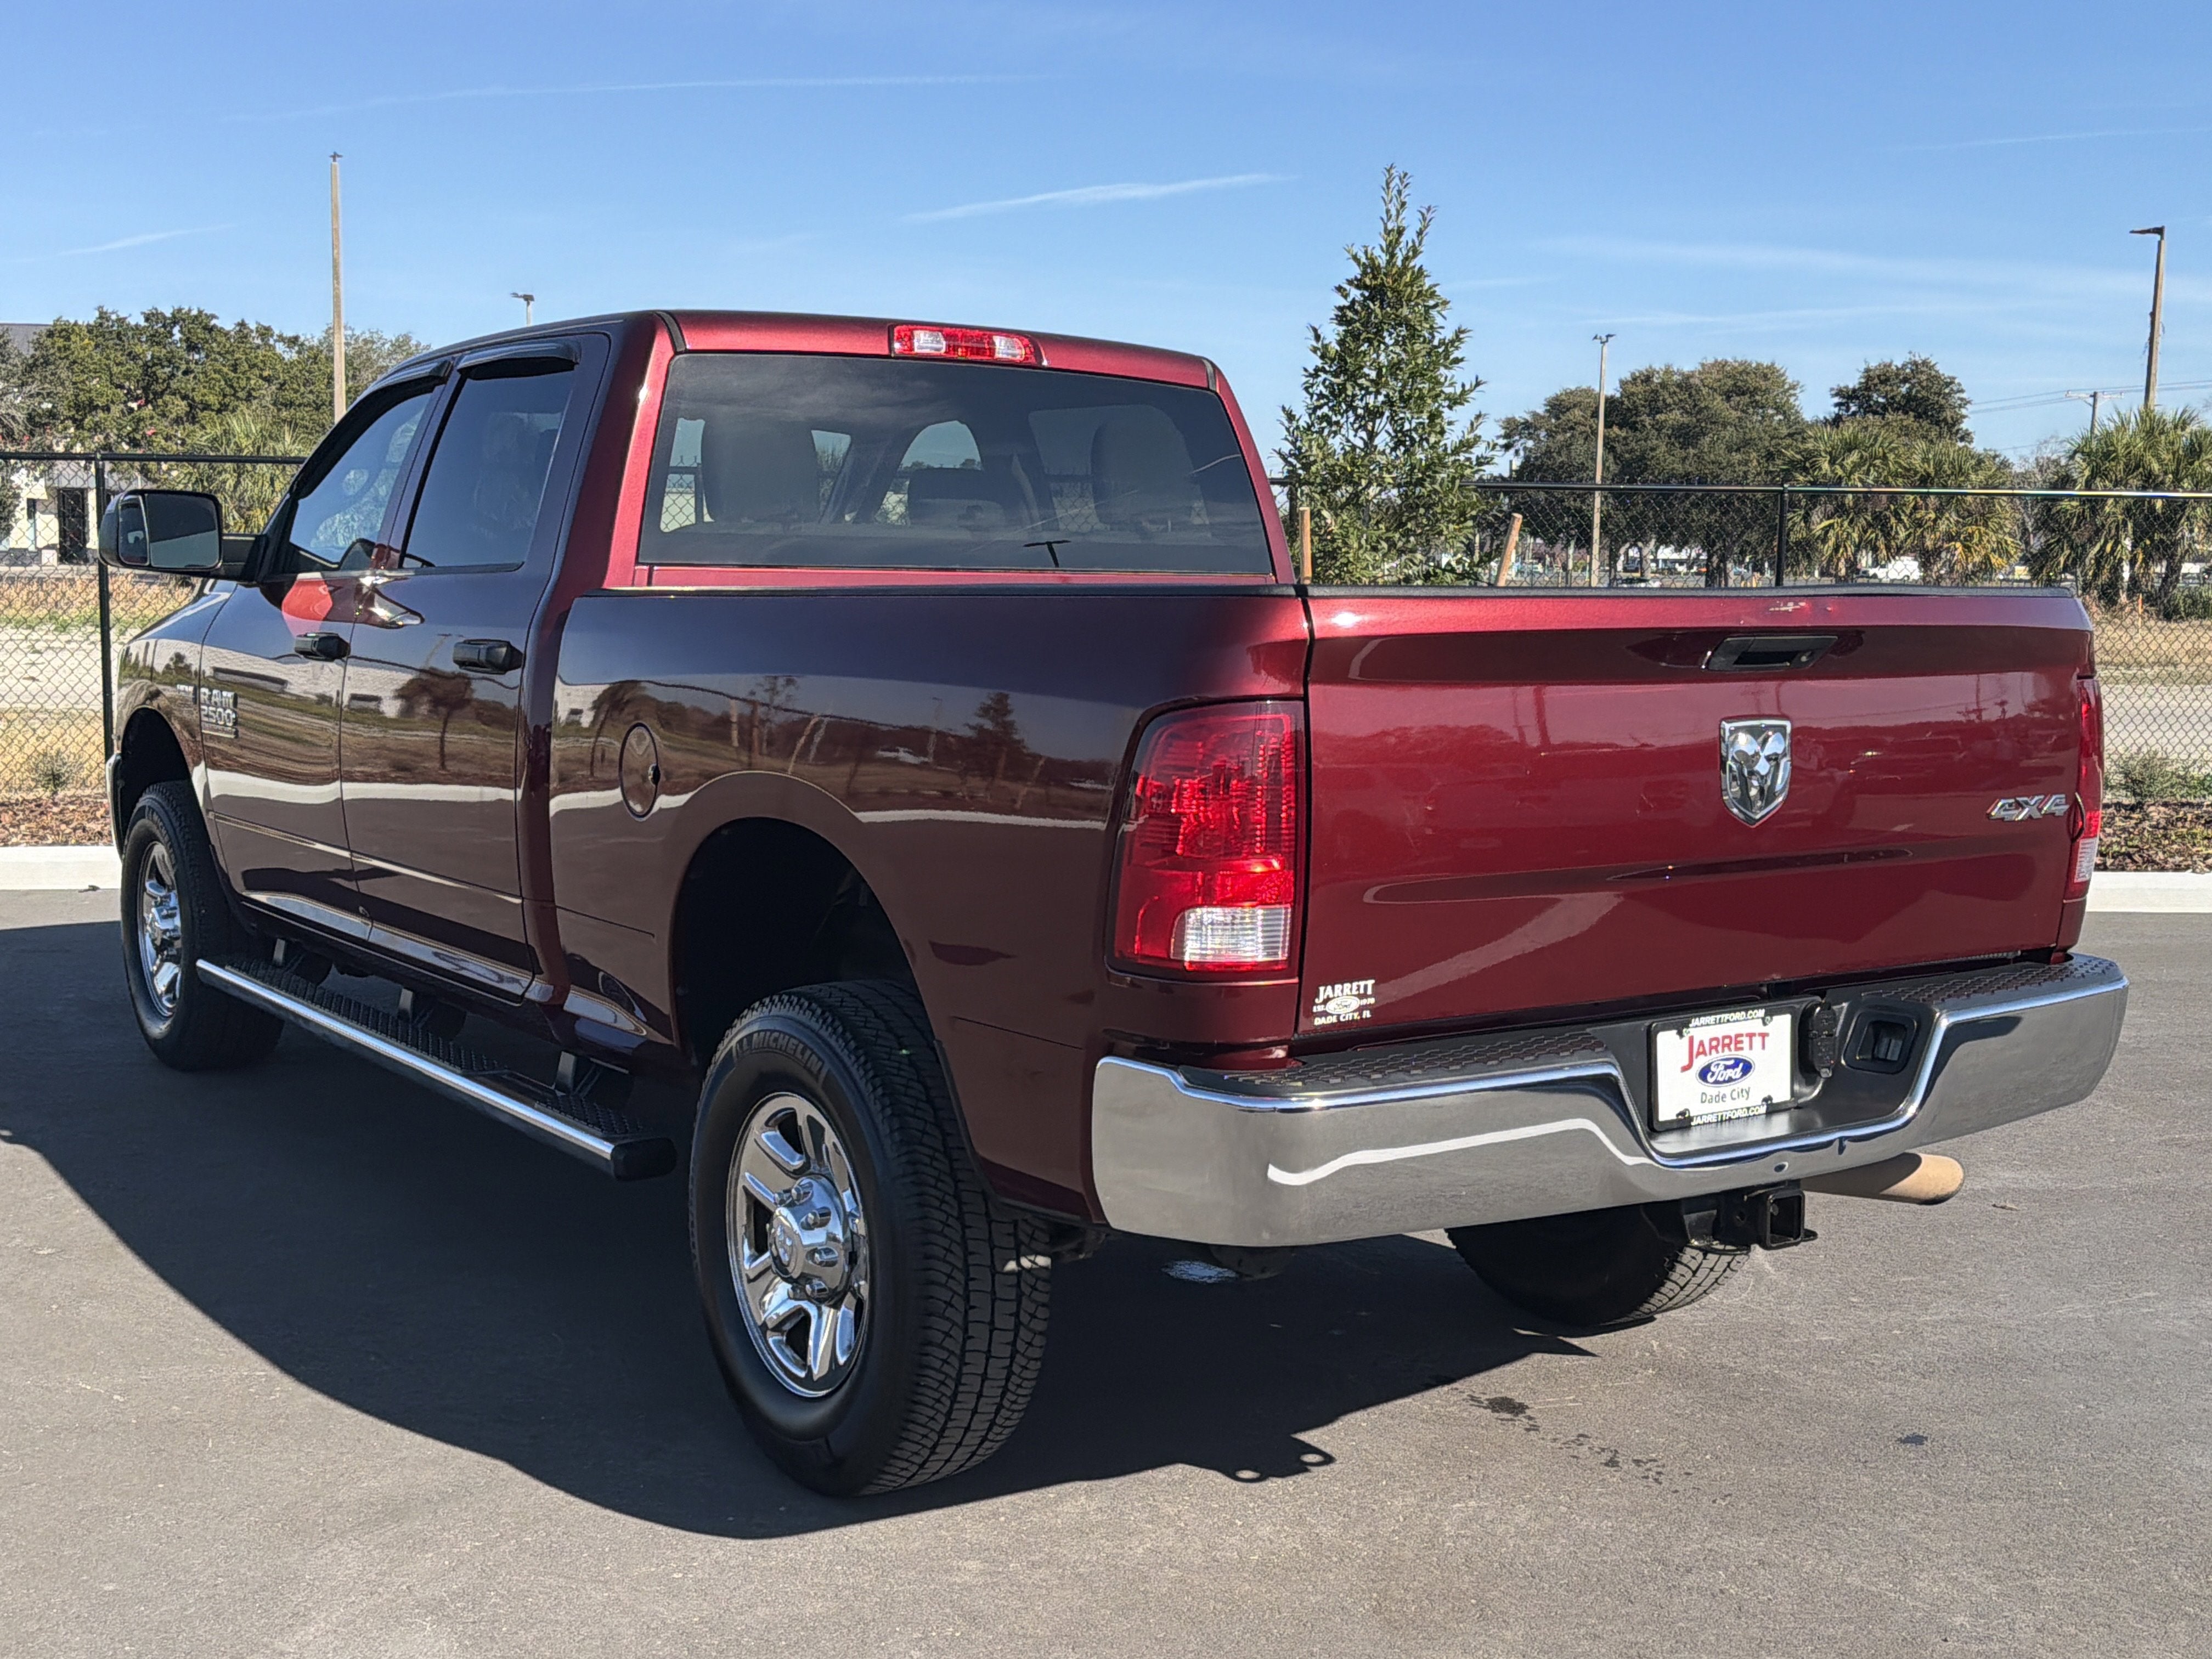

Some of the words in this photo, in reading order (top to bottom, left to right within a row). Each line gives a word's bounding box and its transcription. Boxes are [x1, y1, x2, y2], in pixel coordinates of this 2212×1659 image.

[200, 687, 235, 709] RAM
[200, 706, 235, 726] 2500
[1314, 979, 1375, 1004] JARRETT
[1314, 1015, 1338, 1026] DADE
[1362, 1010, 1372, 1019] FL
[1689, 1008, 1765, 1028] JARRETTFORD.COM
[751, 1031, 822, 1074] MICHELIN
[1680, 1032, 1770, 1073] JARRETT
[1707, 1059, 1744, 1083] Ford
[1700, 1091, 1727, 1104] Dade
[1730, 1086, 1751, 1101] City
[1691, 1104, 1767, 1126] JARRETTFORD.COM
